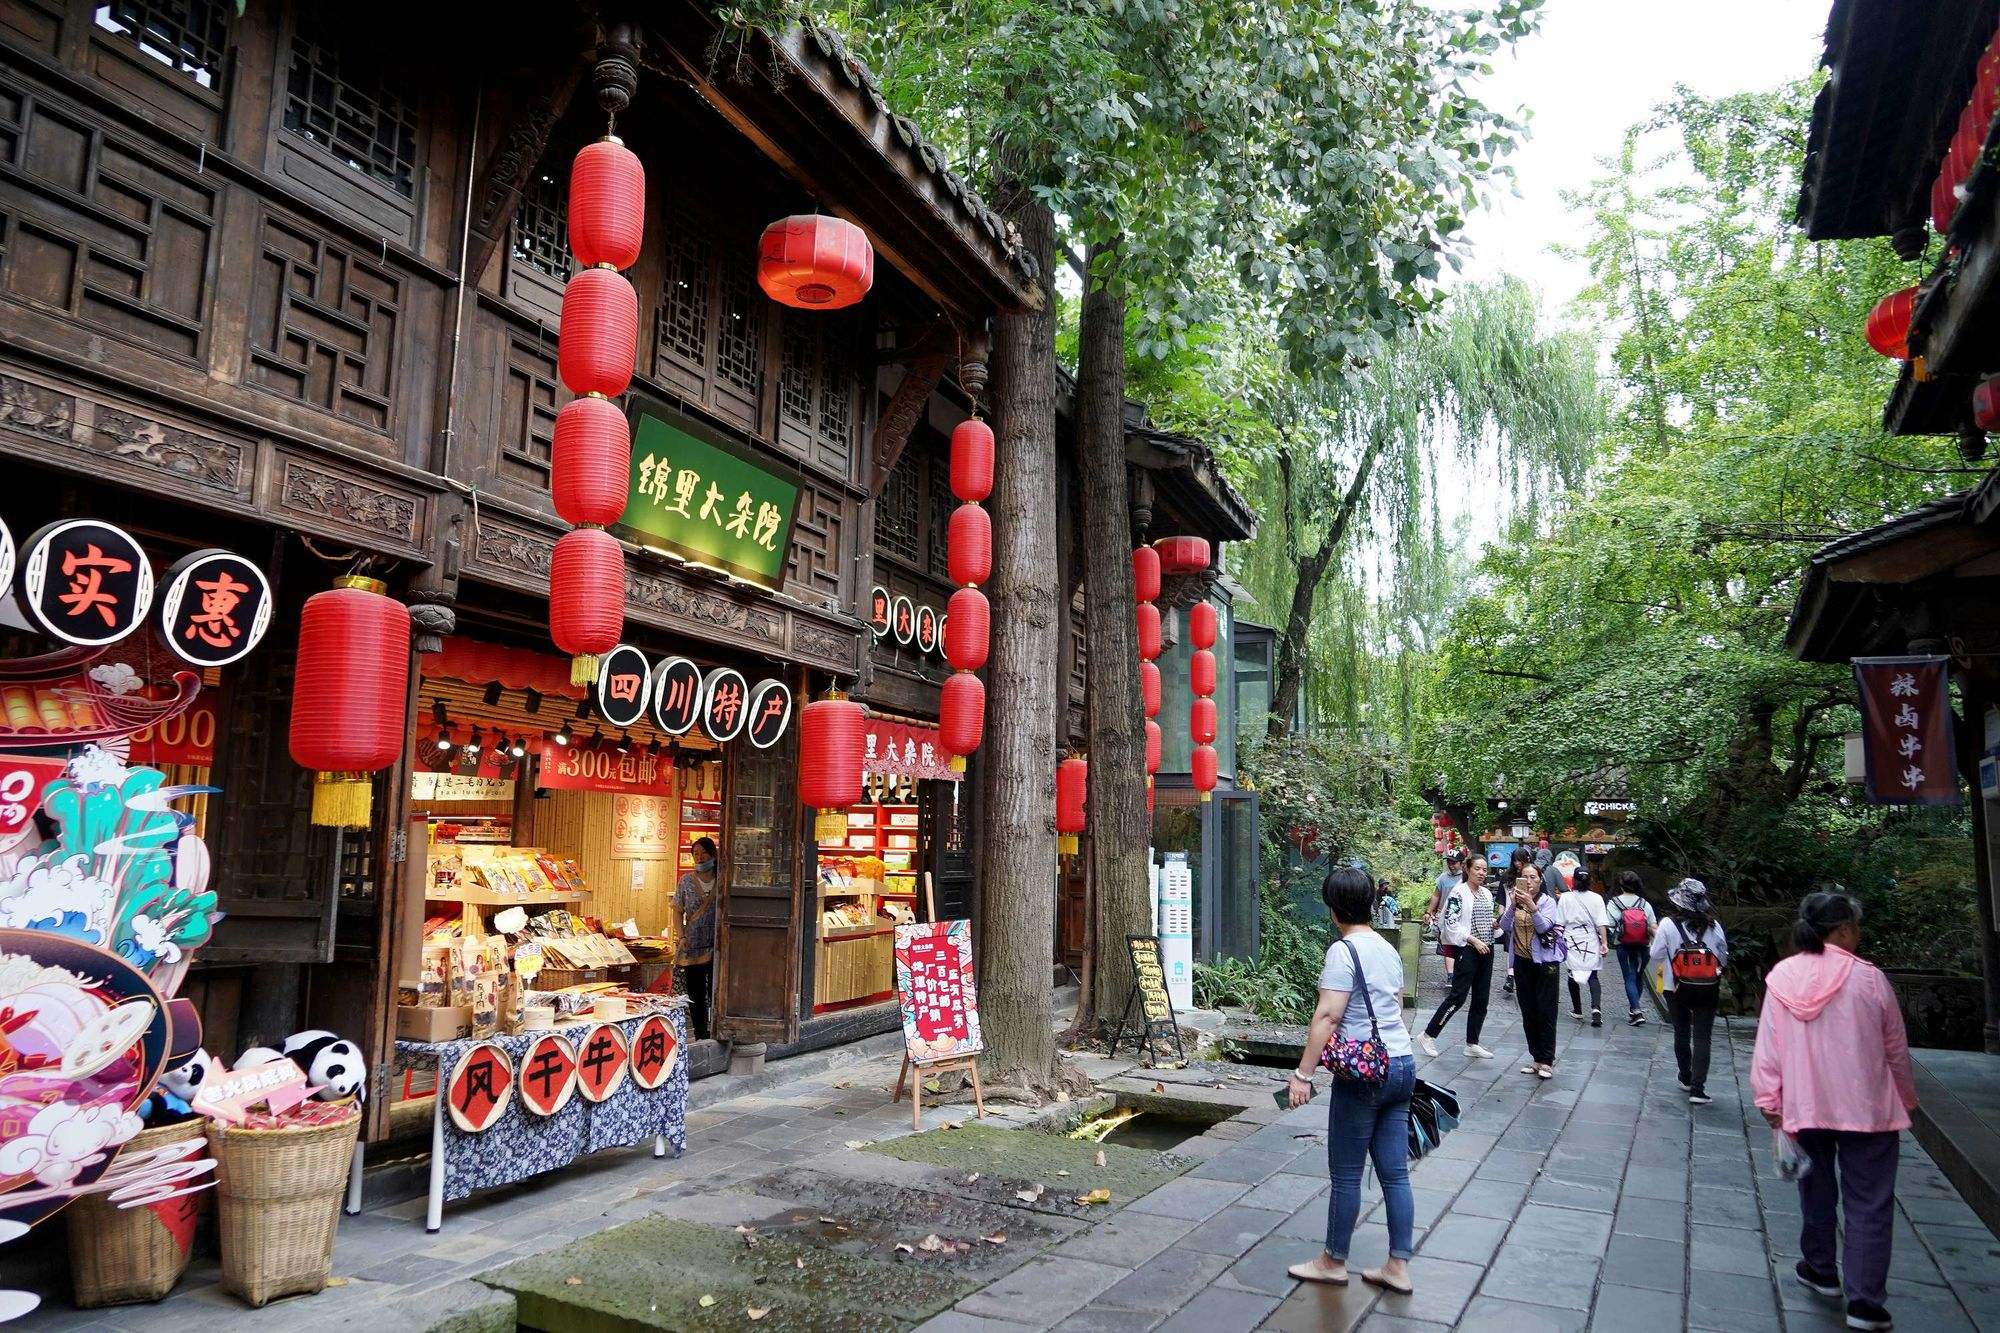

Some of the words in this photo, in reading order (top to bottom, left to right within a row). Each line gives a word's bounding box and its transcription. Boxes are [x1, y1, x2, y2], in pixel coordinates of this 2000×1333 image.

[638, 452, 782, 552] 锦里大杂院
[58, 543, 250, 648] 实惠
[609, 673, 784, 735] 四川特产
[557, 748, 658, 785] 满300元包邮
[460, 1028, 666, 1114] 风干牛肉
